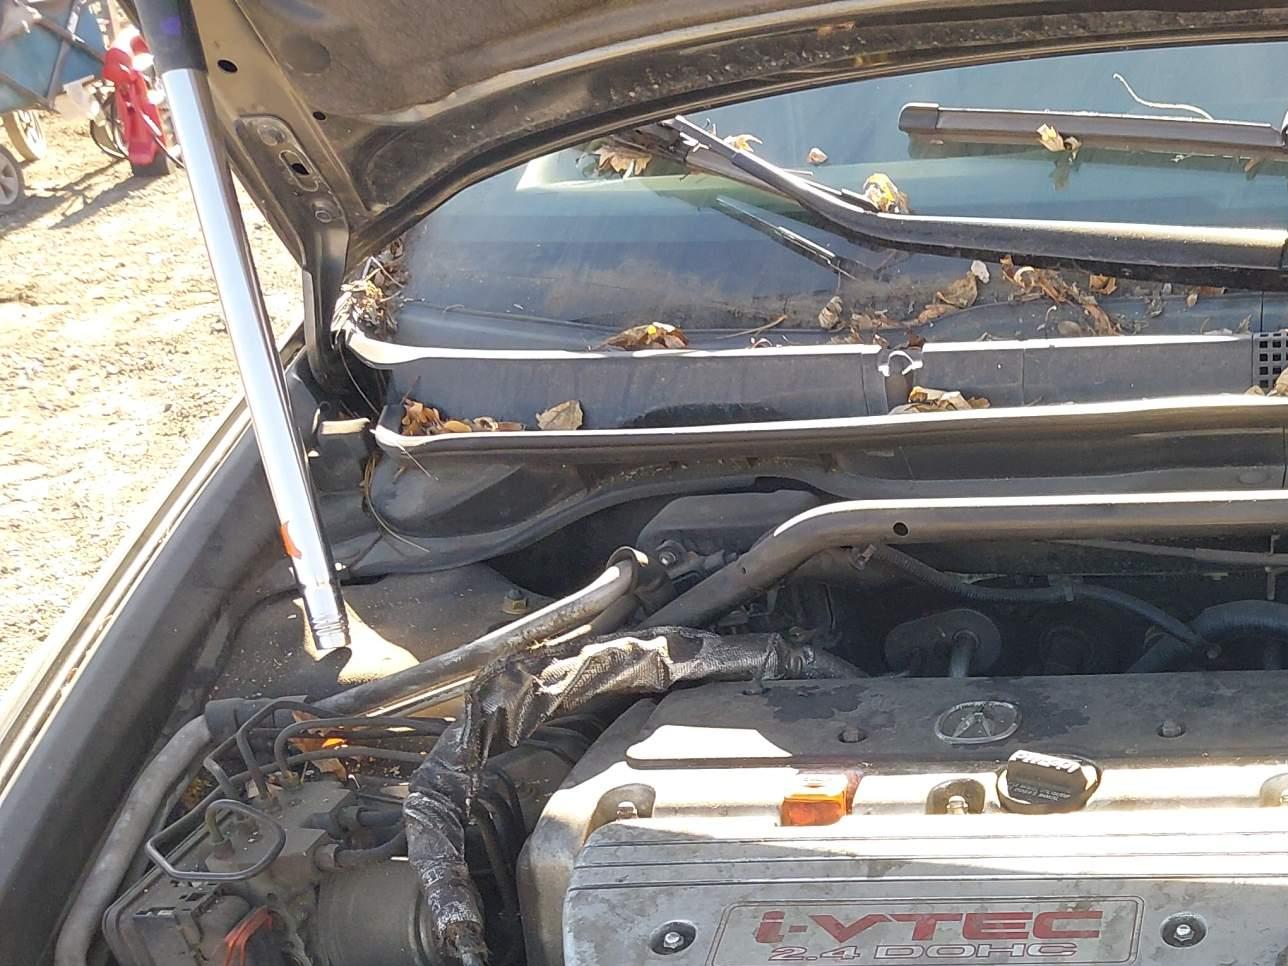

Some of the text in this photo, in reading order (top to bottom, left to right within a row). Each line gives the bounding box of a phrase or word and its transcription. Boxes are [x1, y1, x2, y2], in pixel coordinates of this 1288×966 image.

[755, 910, 1104, 944] i-VTEC
[768, 942, 1078, 961] 2.4 DOHC
